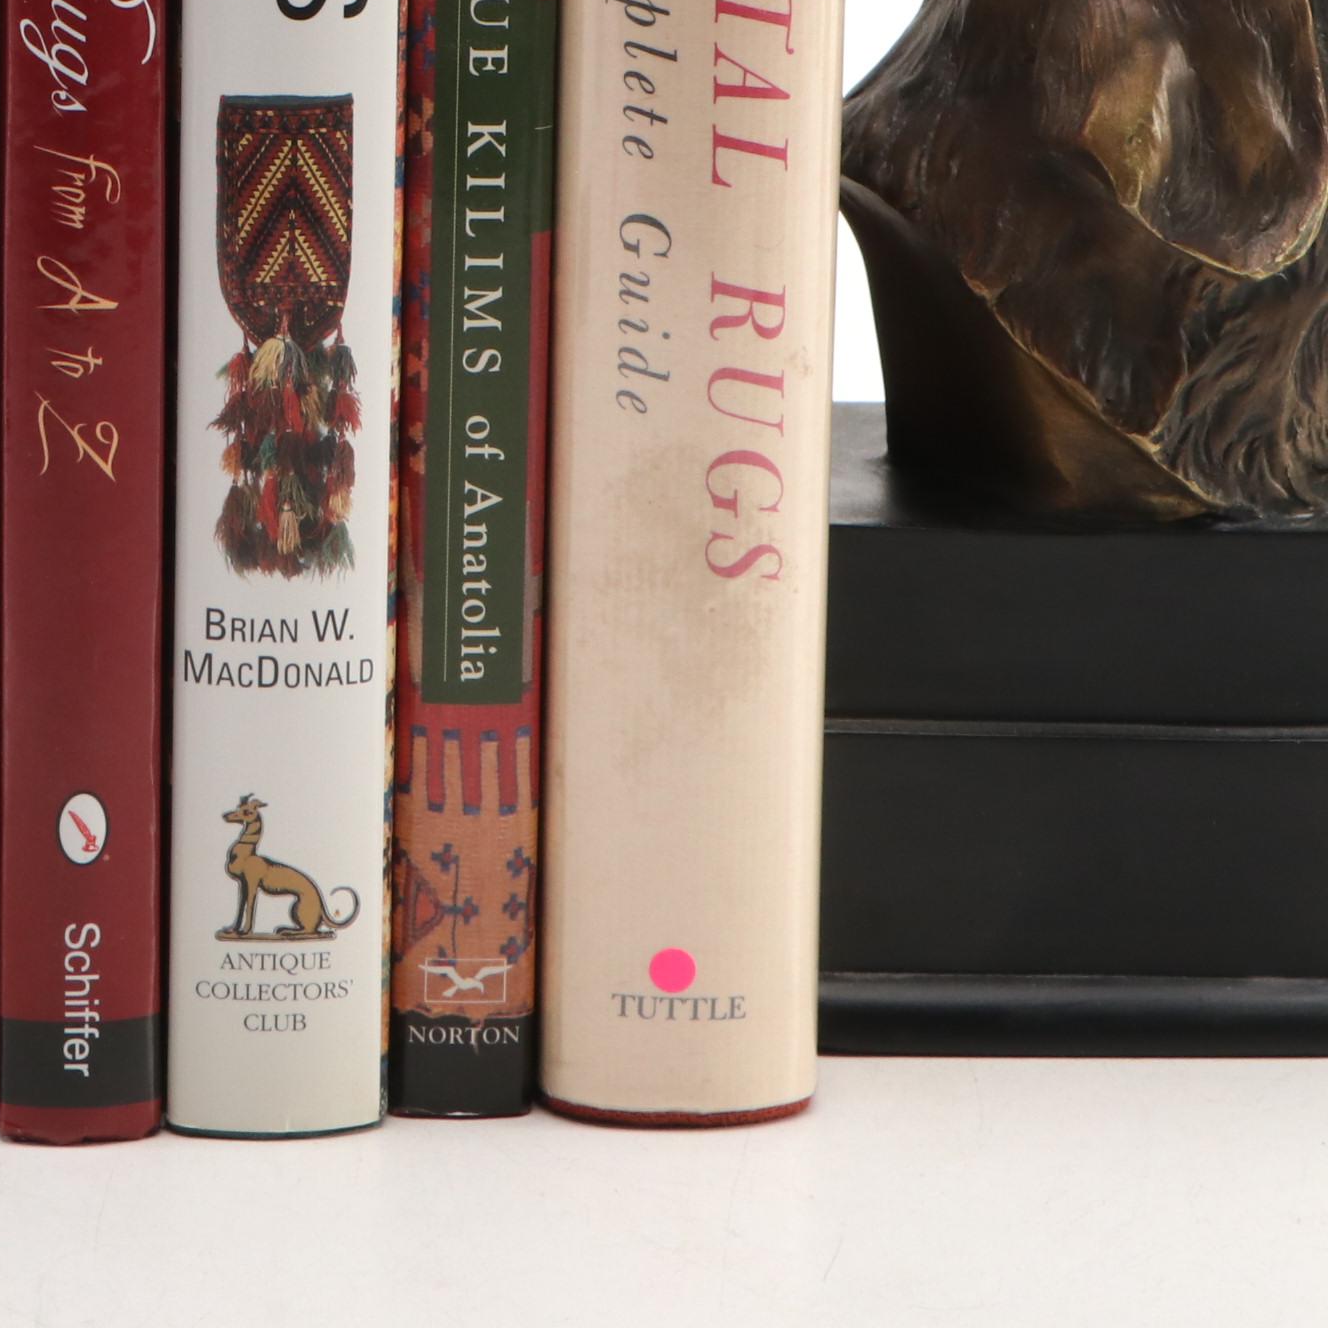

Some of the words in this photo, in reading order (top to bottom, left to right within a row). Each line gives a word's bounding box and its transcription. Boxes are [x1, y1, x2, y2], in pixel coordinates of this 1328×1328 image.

[34, 143, 121, 228] from
[461, 119, 510, 374] KILIMS
[37, 254, 118, 315] A
[614, 213, 673, 415] Guide
[48, 346, 103, 378] to
[38, 389, 117, 482] Z
[464, 414, 505, 460] of
[704, 272, 787, 581] RUGS
[460, 480, 505, 682] Anatolia
[312, 608, 355, 640] W.
[220, 952, 331, 975] ANTIQUE
[63, 922, 101, 1077] Schiffer
[243, 1012, 307, 1032] CLUB
[611, 993, 746, 1021] TUTTLE
[408, 1025, 520, 1045] NORTON
